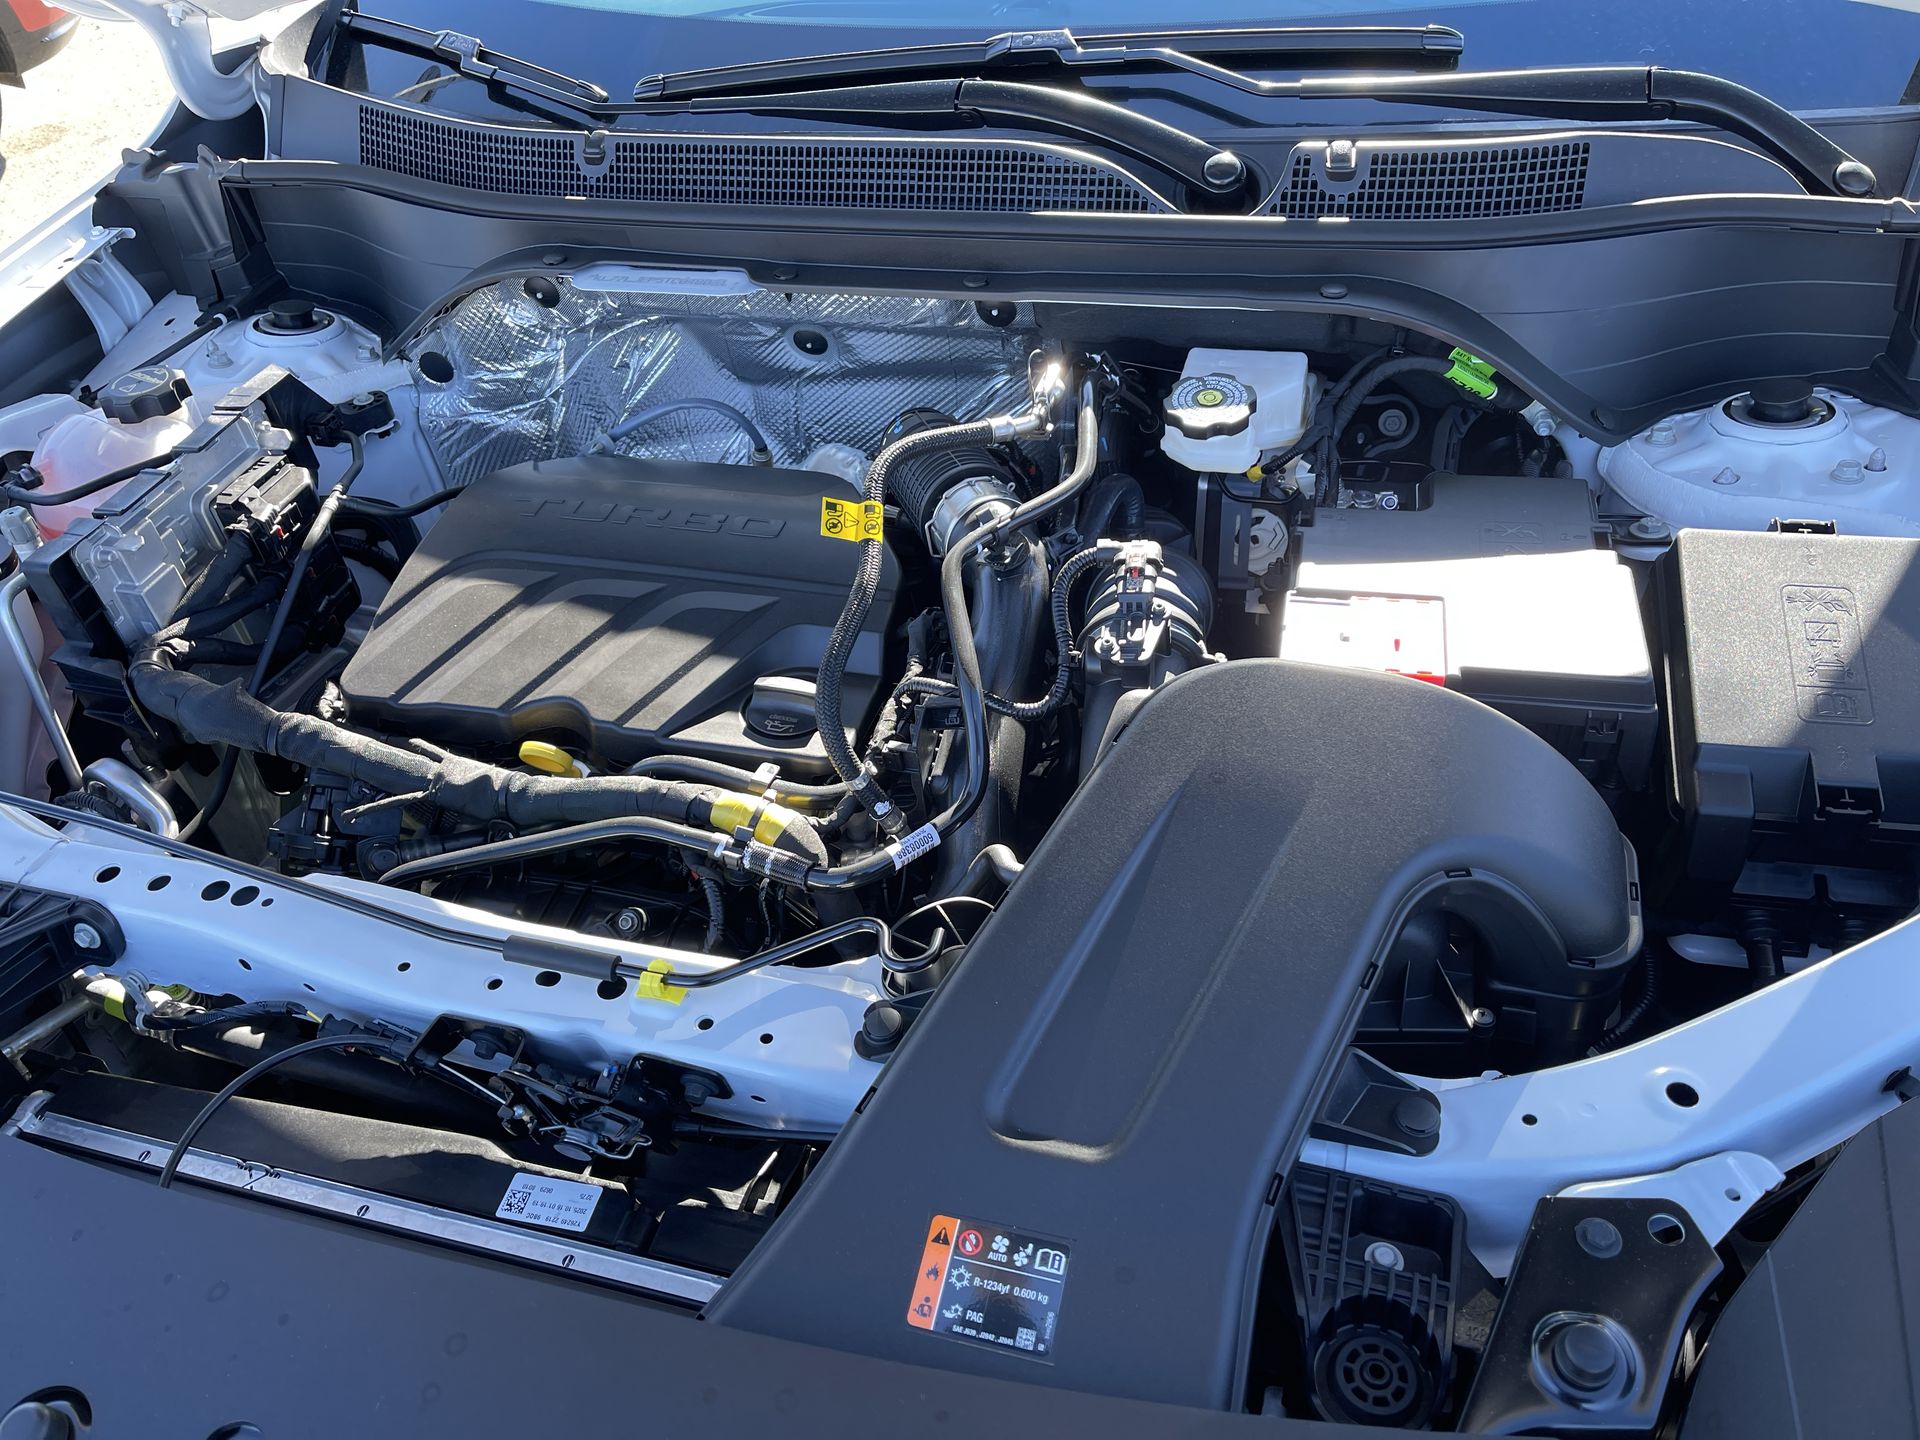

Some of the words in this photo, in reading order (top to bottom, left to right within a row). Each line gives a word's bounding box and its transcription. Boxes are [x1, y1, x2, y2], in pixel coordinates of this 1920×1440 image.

[514, 497, 787, 539] TURBO
[896, 832, 934, 860] 60008388
[987, 1251, 1008, 1263] AUTO
[973, 1277, 1010, 1295] R-1234yf
[1013, 1286, 1037, 1301] 0.600
[1037, 1290, 1049, 1305] kg
[965, 1310, 984, 1324] PAG
[952, 1324, 963, 1333] SAE
